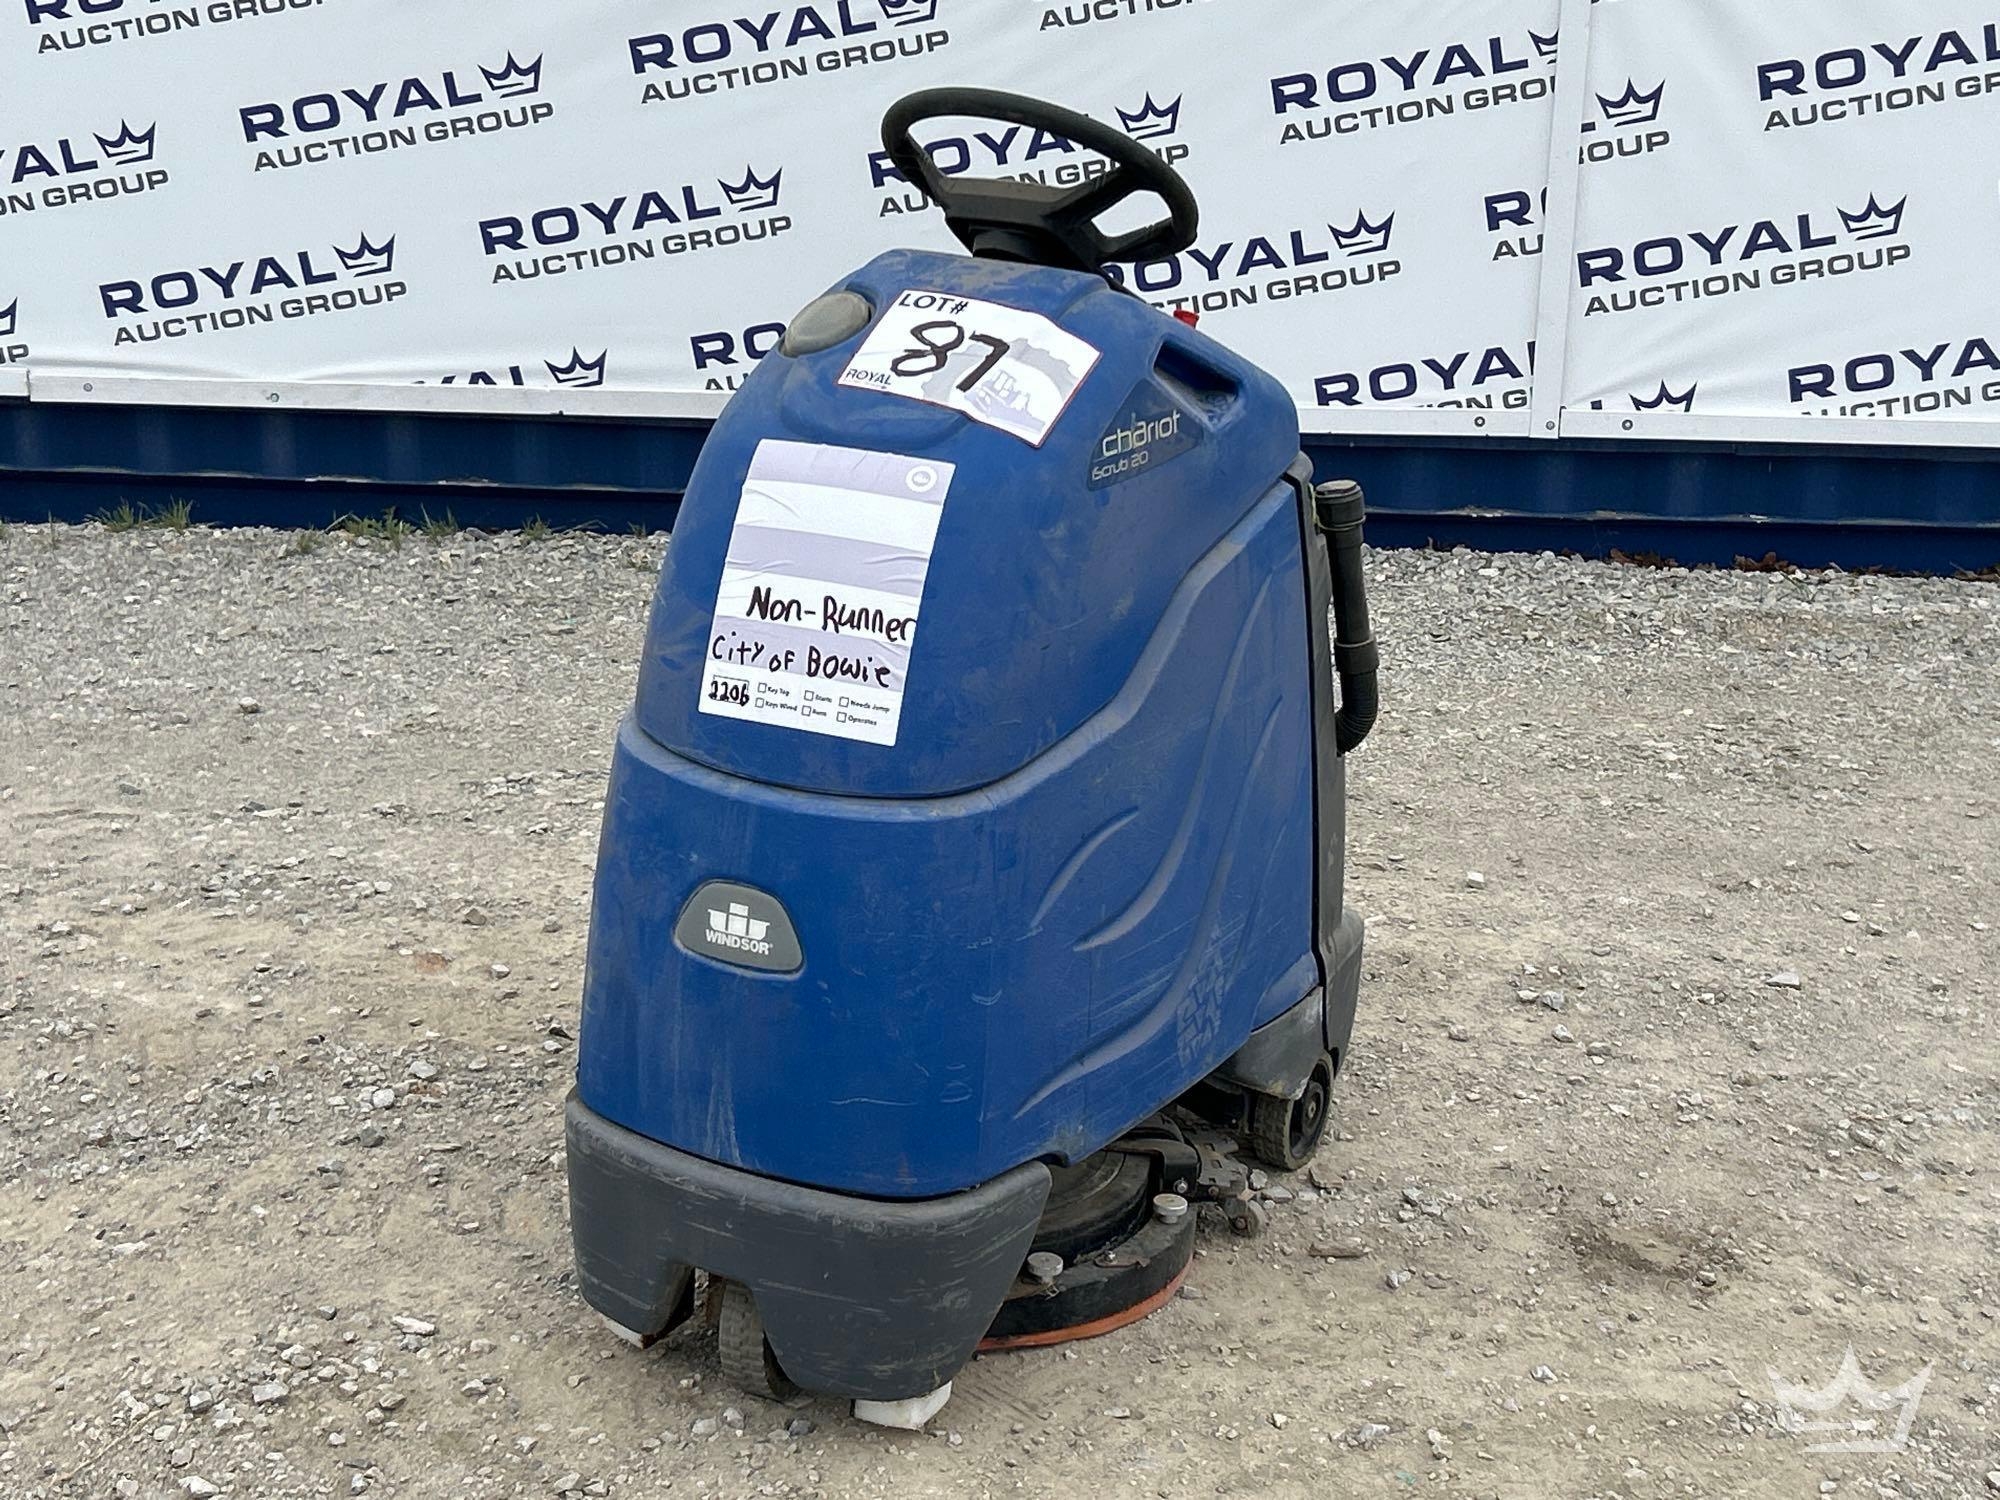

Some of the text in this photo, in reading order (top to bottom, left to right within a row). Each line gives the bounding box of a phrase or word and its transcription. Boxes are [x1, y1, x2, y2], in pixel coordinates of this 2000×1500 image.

[39, 8, 199, 53] AUCTION
[629, 0, 877, 74] ROYAL
[642, 31, 949, 104] AUCTION GROUP
[1271, 37, 1528, 114] ROYAL
[239, 72, 483, 143] ROYAL
[255, 103, 553, 171] AUCTION GROUP
[1280, 75, 1555, 144] AUCTION GRO
[1764, 82, 1944, 131] AUCTION
[43, 170, 168, 207] GROUP
[479, 186, 721, 255] ROYAL
[493, 216, 791, 283] AUCTION GROUP
[1267, 261, 1400, 300] GROUP
[1577, 214, 1836, 287] ROYAL
[1585, 245, 1910, 316] AUCTION GROUP
[99, 251, 337, 318] ROYAL
[115, 282, 406, 346] AUCTION GROUP
[898, 293, 969, 315] LOT#
[845, 368, 892, 386] ROYAL
[889, 320, 1010, 393] 87
[1314, 341, 1536, 406] ROYA
[1102, 409, 1180, 457] chariot
[1131, 451, 1148, 468] 20
[711, 631, 765, 666] City
[806, 645, 891, 688] Bowie
